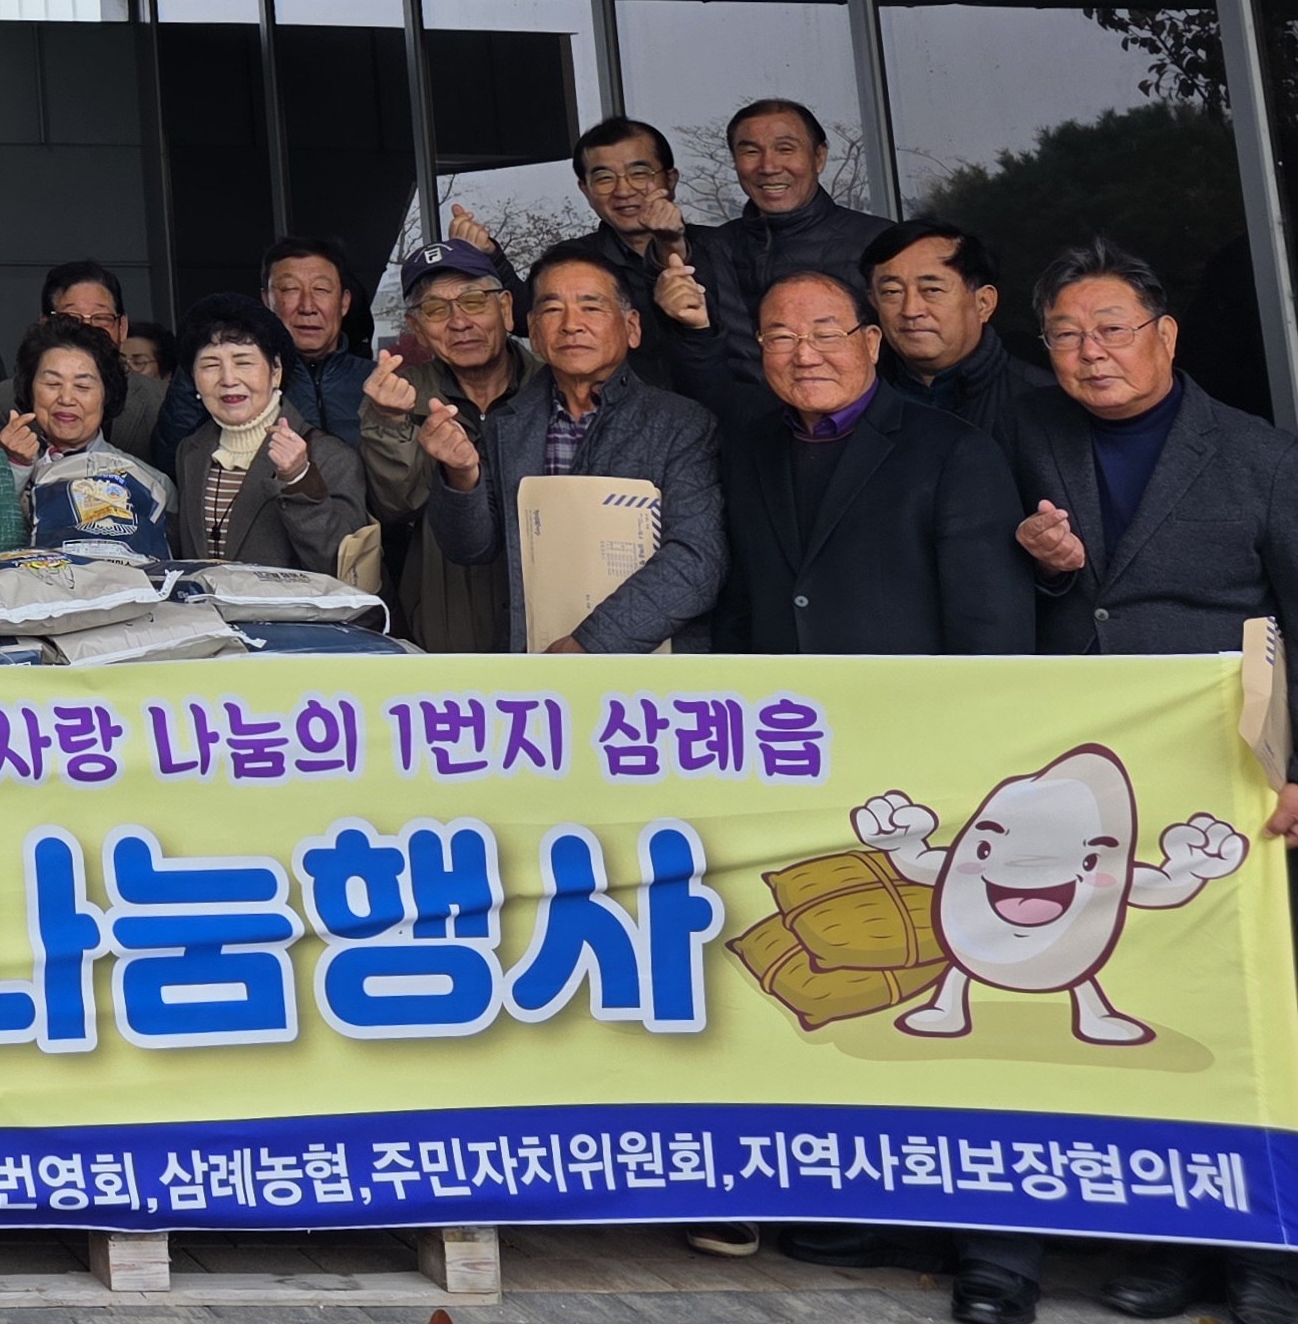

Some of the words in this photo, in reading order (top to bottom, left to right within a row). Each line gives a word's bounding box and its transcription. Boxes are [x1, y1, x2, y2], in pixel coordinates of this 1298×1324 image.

[148, 698, 358, 779] 나눔의
[388, 697, 563, 775] 1번지
[598, 697, 825, 777] 삼례읍
